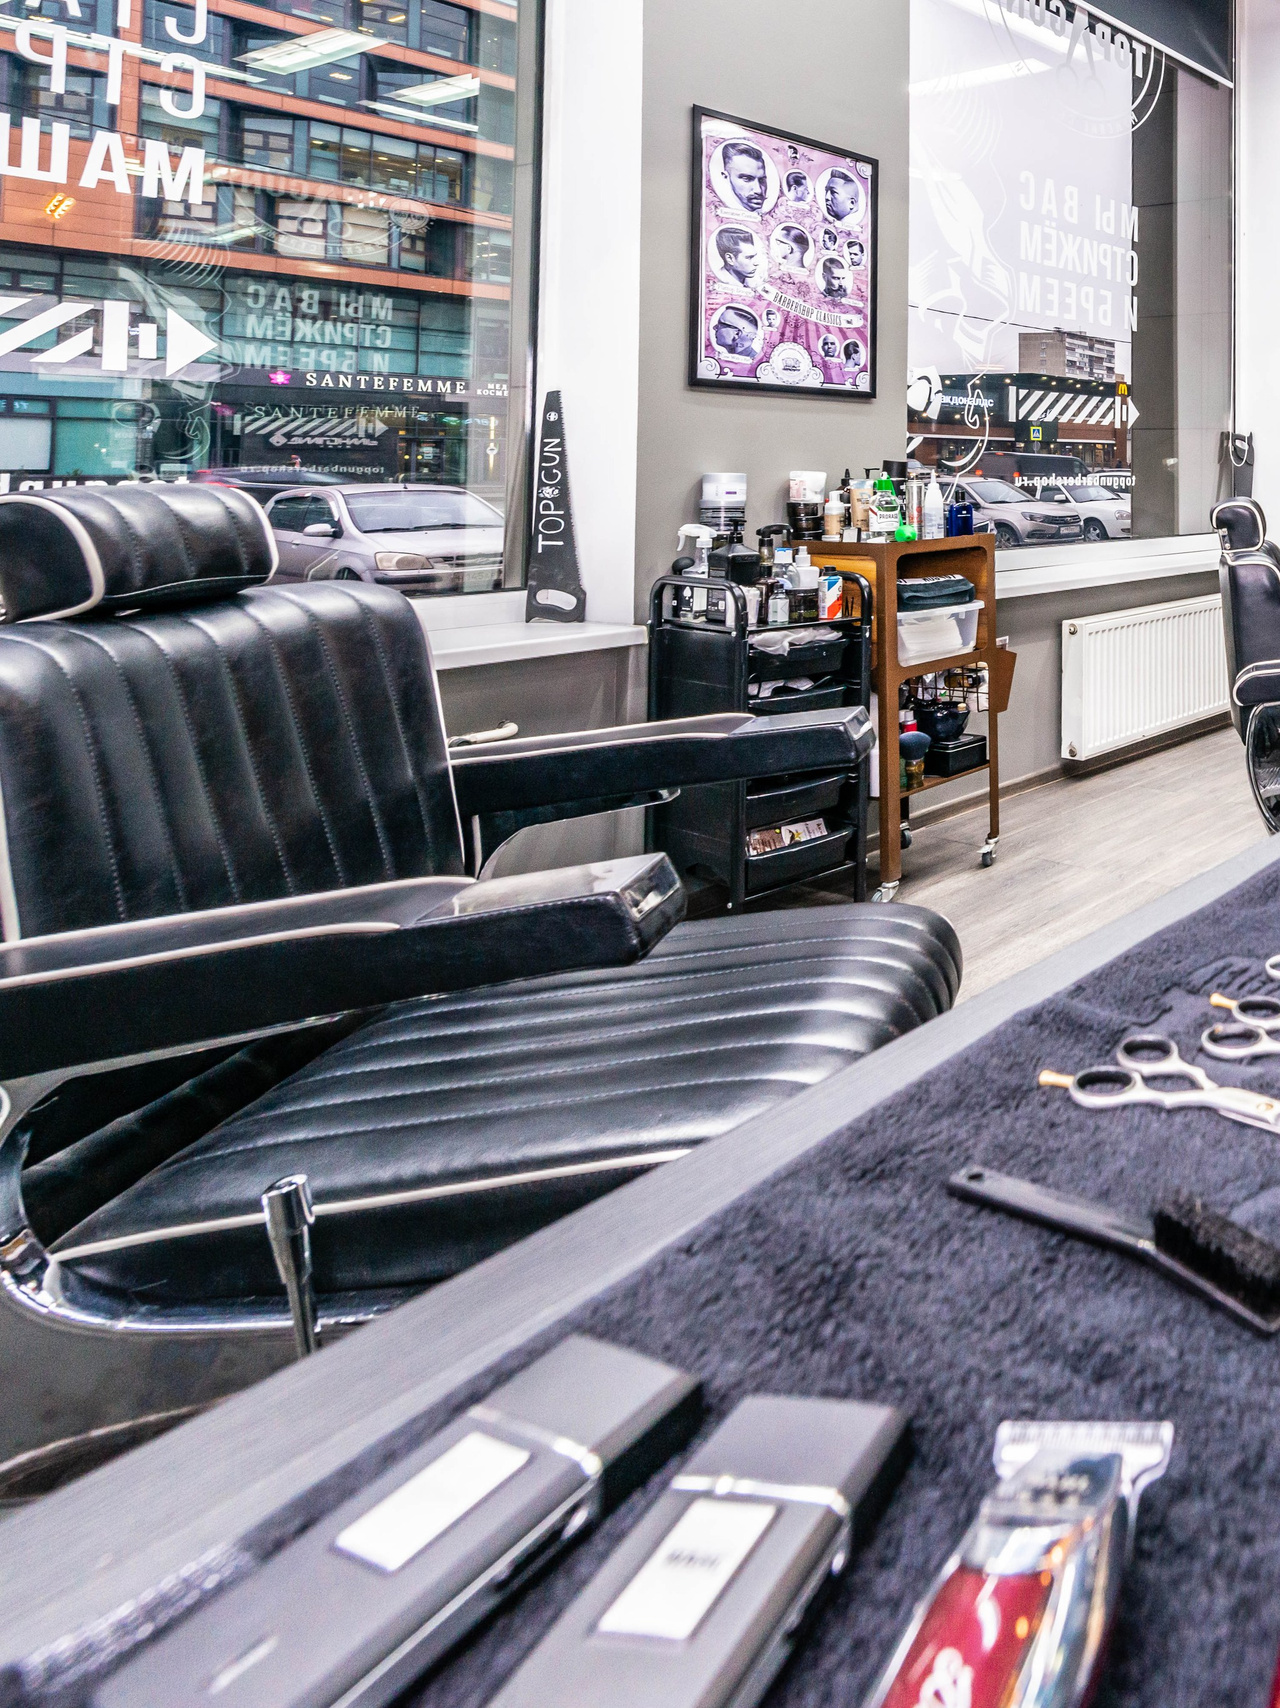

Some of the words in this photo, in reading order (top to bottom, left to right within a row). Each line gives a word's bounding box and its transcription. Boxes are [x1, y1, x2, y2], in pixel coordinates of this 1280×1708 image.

[773, 292, 815, 319] BARBERSHOP
[815, 310, 842, 326] CLASSICS
[305, 373, 466, 394] SANTEFEMME
[541, 438, 562, 484] GUN
[538, 500, 565, 553] TOP
